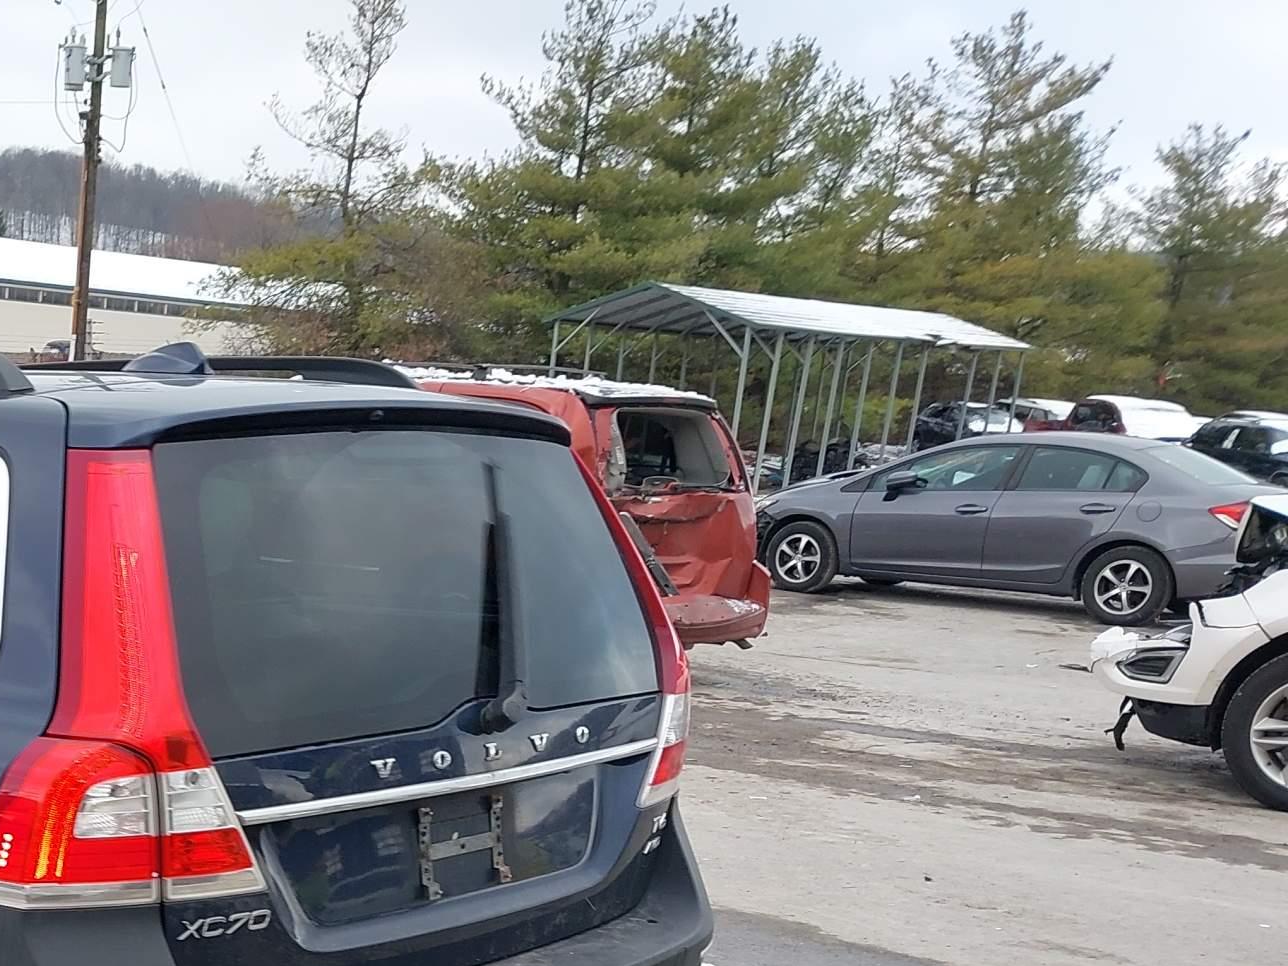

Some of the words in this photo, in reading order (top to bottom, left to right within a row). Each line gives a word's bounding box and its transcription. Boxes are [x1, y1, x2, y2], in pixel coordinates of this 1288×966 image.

[369, 725, 590, 779] VOLVO
[652, 812, 667, 834] T6
[176, 908, 272, 941] XC70
